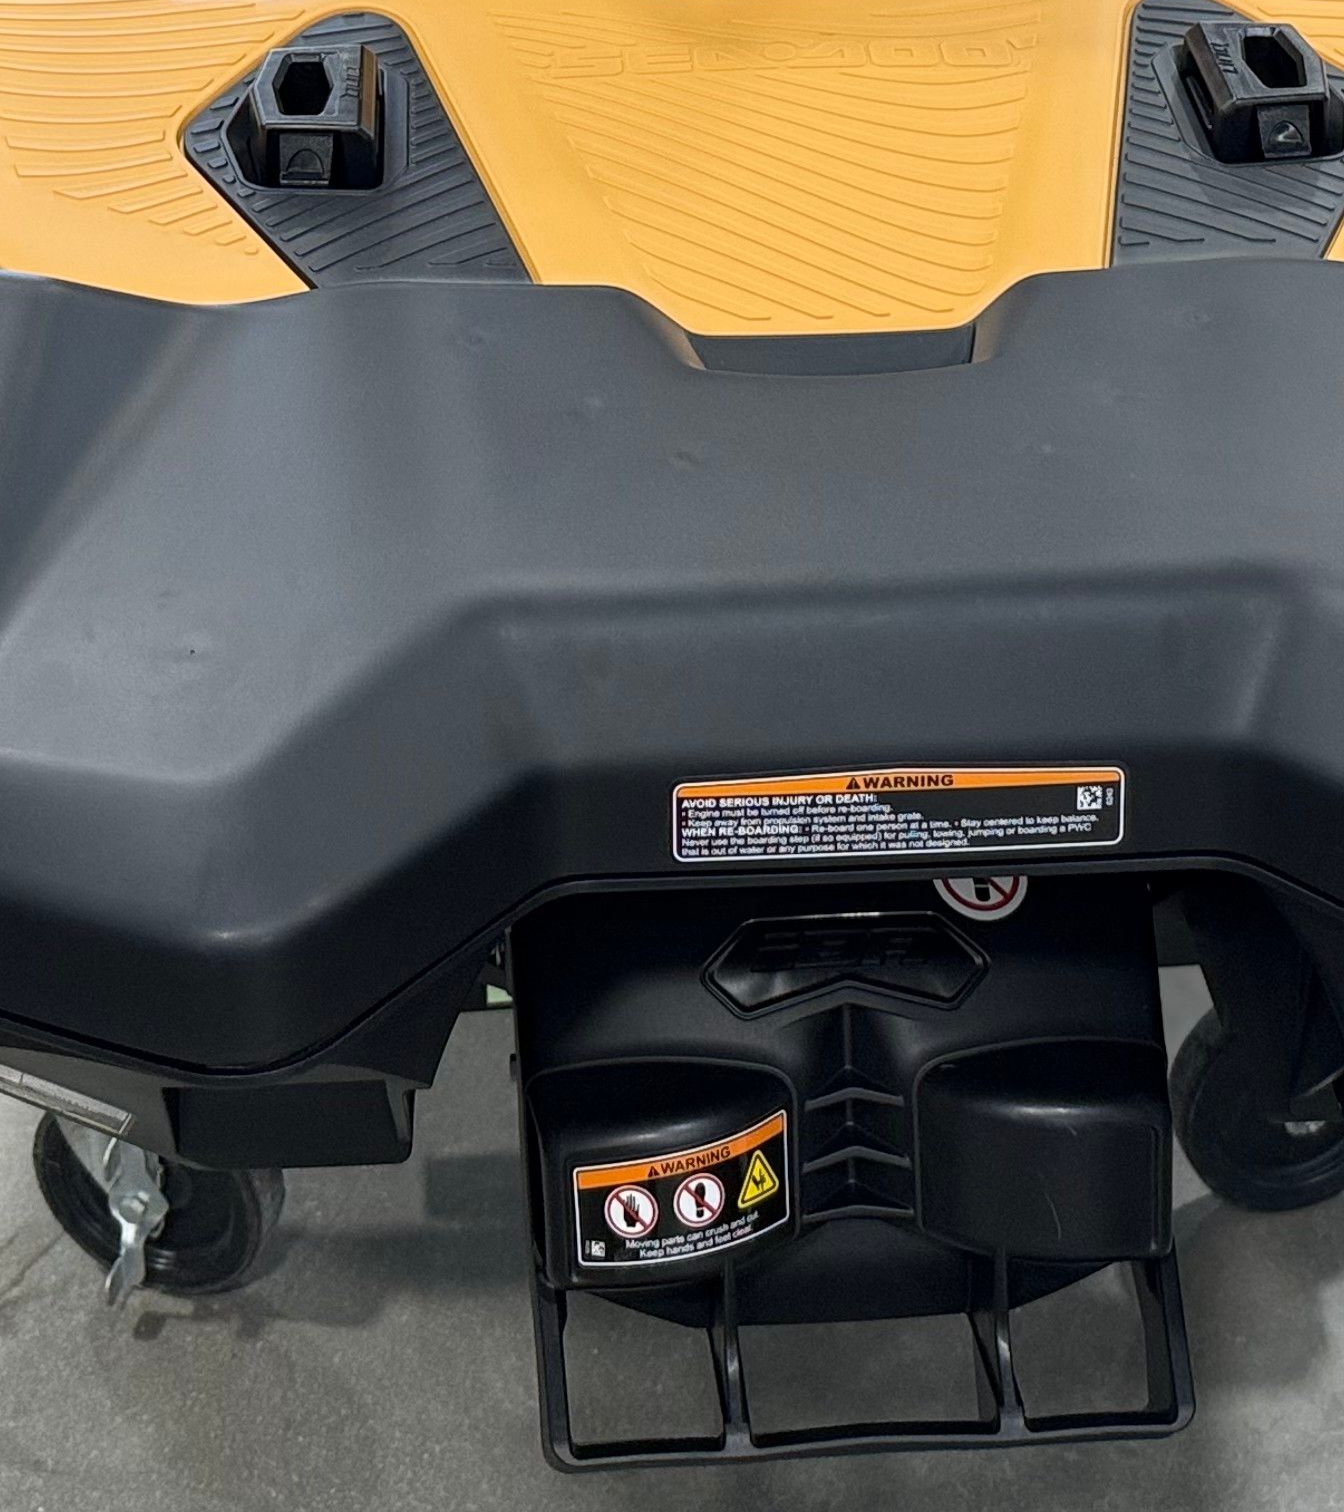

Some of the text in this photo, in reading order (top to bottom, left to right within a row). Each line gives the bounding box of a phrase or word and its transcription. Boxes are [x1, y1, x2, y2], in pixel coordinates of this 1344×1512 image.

[863, 775, 954, 788] WARNING
[681, 794, 877, 808] AVOID SERIOUS INJURY OR DEATH:
[688, 809, 720, 819] Engine
[721, 808, 745, 817] must
[760, 807, 790, 816] turned
[806, 805, 836, 814] before
[837, 804, 893, 813] re-boarding.
[688, 819, 712, 827] Keep
[714, 819, 738, 828] away
[740, 818, 762, 826] from
[763, 816, 811, 826] propulsion
[813, 814, 846, 824] system
[847, 814, 866, 822] and
[867, 814, 896, 822] intake
[681, 828, 716, 837] WHEN
[718, 824, 802, 836] RE-BOARDING:
[811, 824, 855, 833] Re-board
[876, 822, 908, 831] person
[960, 818, 982, 828] Stay
[983, 816, 1024, 827] centered
[1036, 816, 1059, 824] keep
[1061, 814, 1099, 823] balance.
[681, 838, 709, 846] Never
[711, 838, 729, 846] use
[730, 837, 745, 845] the
[747, 836, 787, 845] boarding
[789, 836, 810, 844] step
[967, 828, 1004, 838] jumping
[1017, 826, 1057, 835] boarding
[1068, 823, 1092, 832] PWC
[681, 848, 700, 856] that
[739, 846, 765, 854] water
[778, 846, 796, 854] any
[797, 844, 836, 853] purpose
[851, 842, 878, 850] which
[888, 841, 907, 849] was
[908, 840, 924, 848] not
[661, 1145, 731, 1174] WARNING
[625, 1239, 660, 1249] Moving
[661, 1236, 685, 1248] parts
[687, 1232, 704, 1241] can
[705, 1224, 729, 1237] crush
[730, 1216, 746, 1229] and
[640, 1249, 664, 1258] Keep
[666, 1244, 695, 1255] hands
[696, 1238, 714, 1249] and
[715, 1232, 731, 1244] feet
